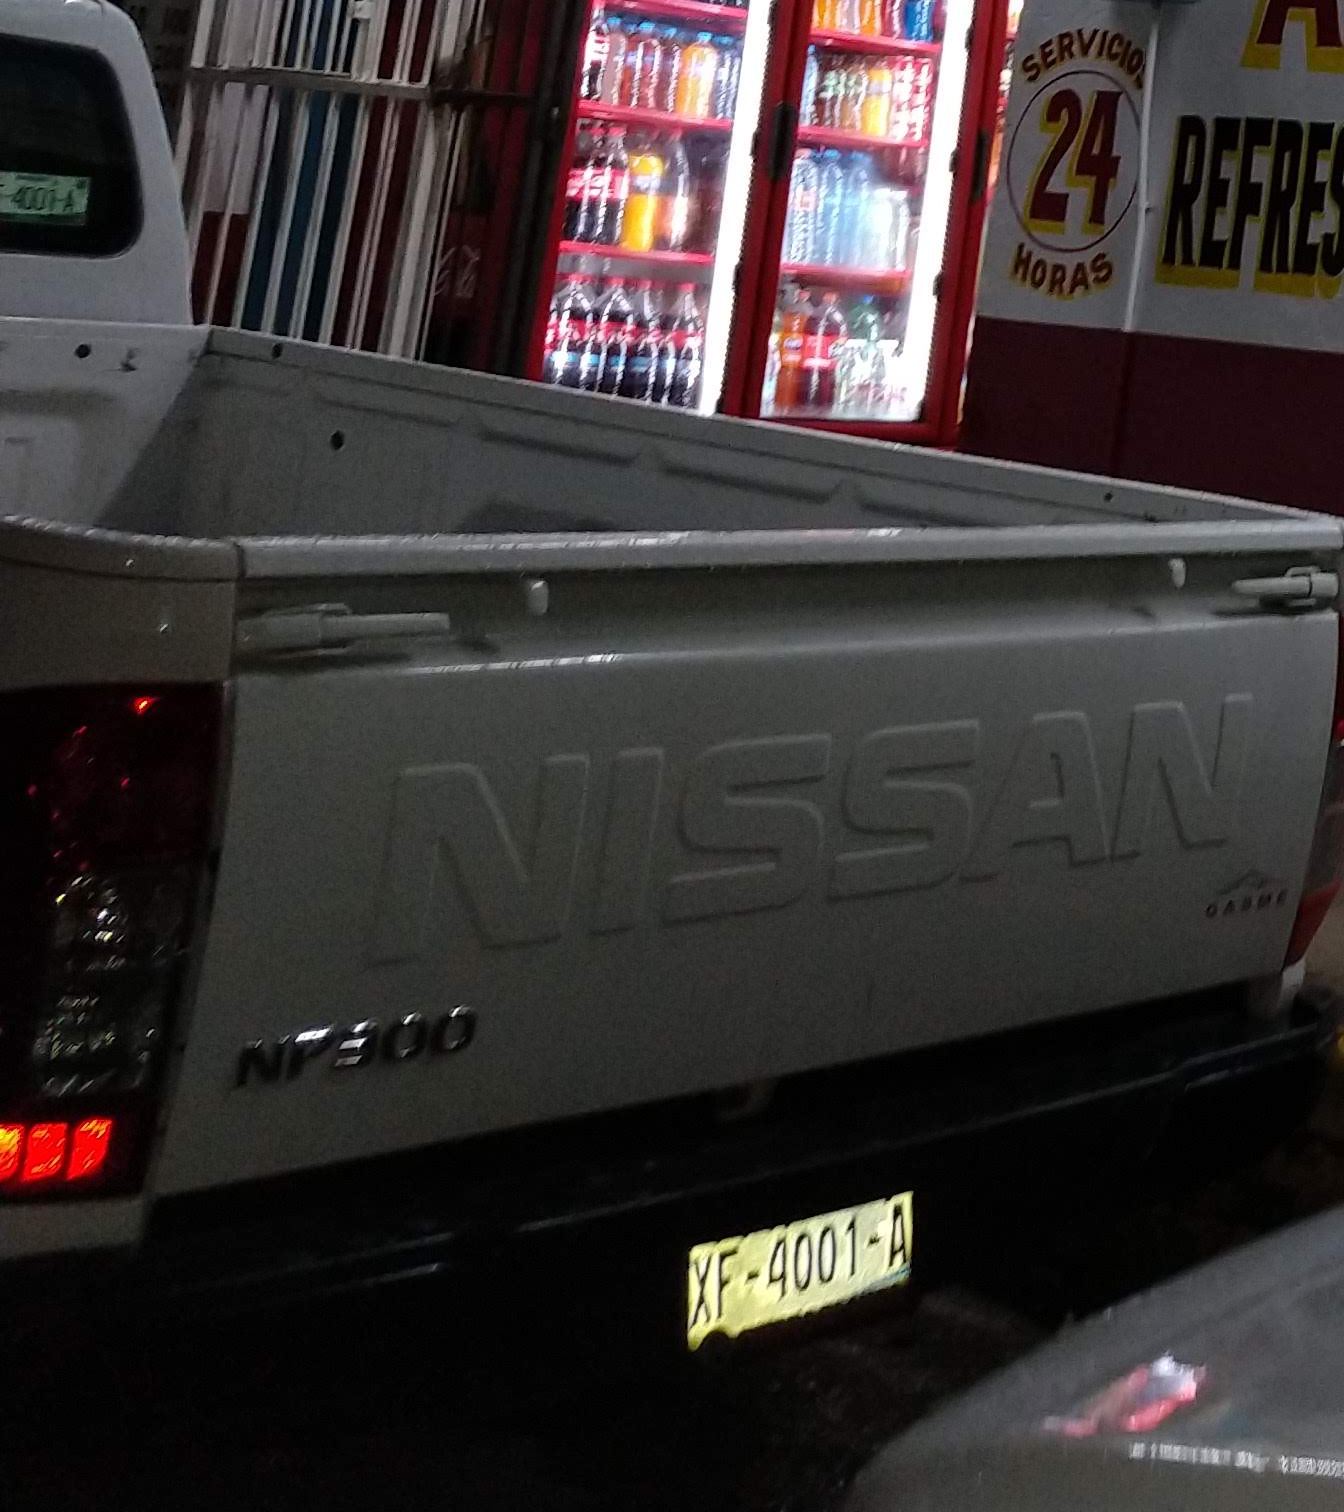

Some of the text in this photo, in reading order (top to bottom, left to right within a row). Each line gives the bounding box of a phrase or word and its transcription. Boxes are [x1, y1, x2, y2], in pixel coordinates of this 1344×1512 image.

[1023, 88, 1123, 235] 24
[1009, 243, 1113, 300] HORAS
[366, 692, 1254, 968] NISSAN
[687, 1202, 909, 1330] XF-4001-A
